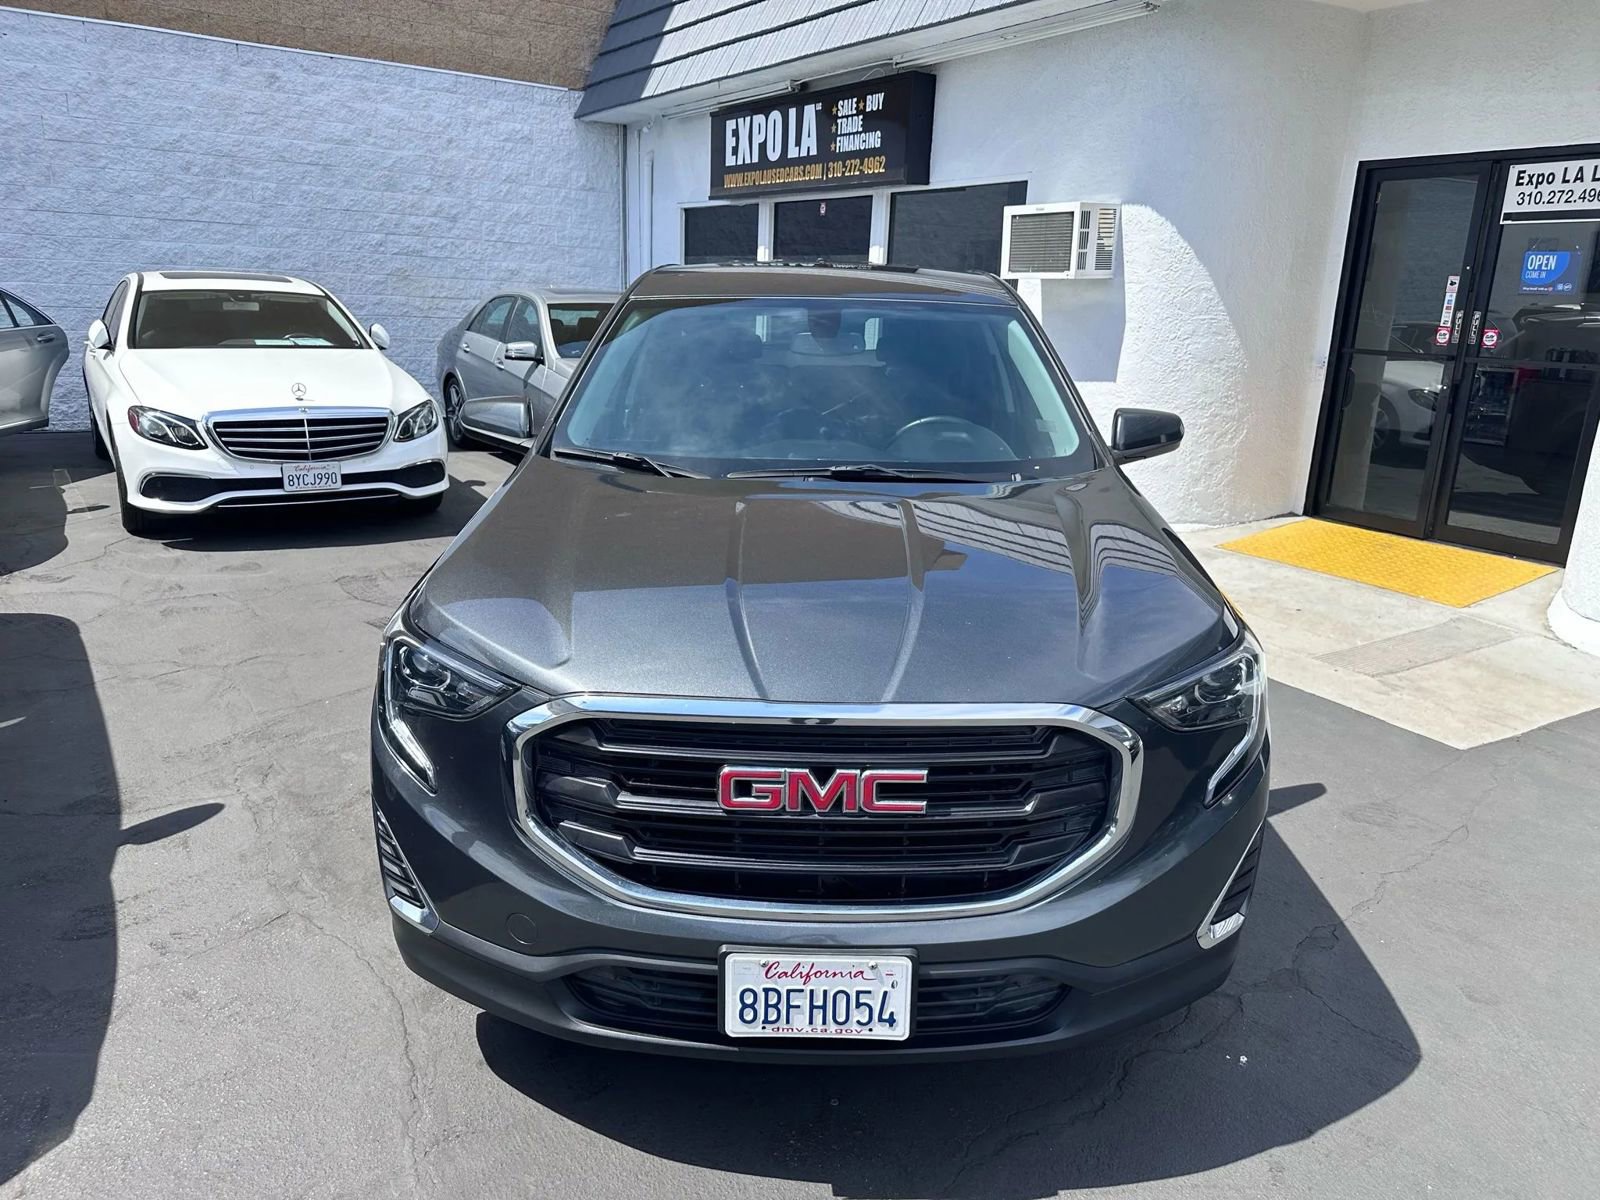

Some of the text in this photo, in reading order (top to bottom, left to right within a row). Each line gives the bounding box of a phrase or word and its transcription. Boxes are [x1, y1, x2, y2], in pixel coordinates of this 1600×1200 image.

[837, 92, 885, 117] SALE BUY
[725, 110, 783, 167] EXPO
[787, 104, 818, 158] LA
[836, 114, 863, 135] TRADE
[835, 130, 881, 153] FINANCING
[827, 155, 886, 178] 310-272-4962
[1515, 169, 1556, 190] Expo
[1561, 165, 1585, 184] LA
[1527, 254, 1557, 270] OPEN
[1525, 271, 1540, 279] COME
[287, 472, 338, 487] 8YCJ990
[294, 464, 328, 473] California
[719, 765, 928, 813] GMC
[764, 960, 878, 986] California
[738, 987, 897, 1028] 8BFH054
[771, 1026, 864, 1035] dmv.ca.gov
